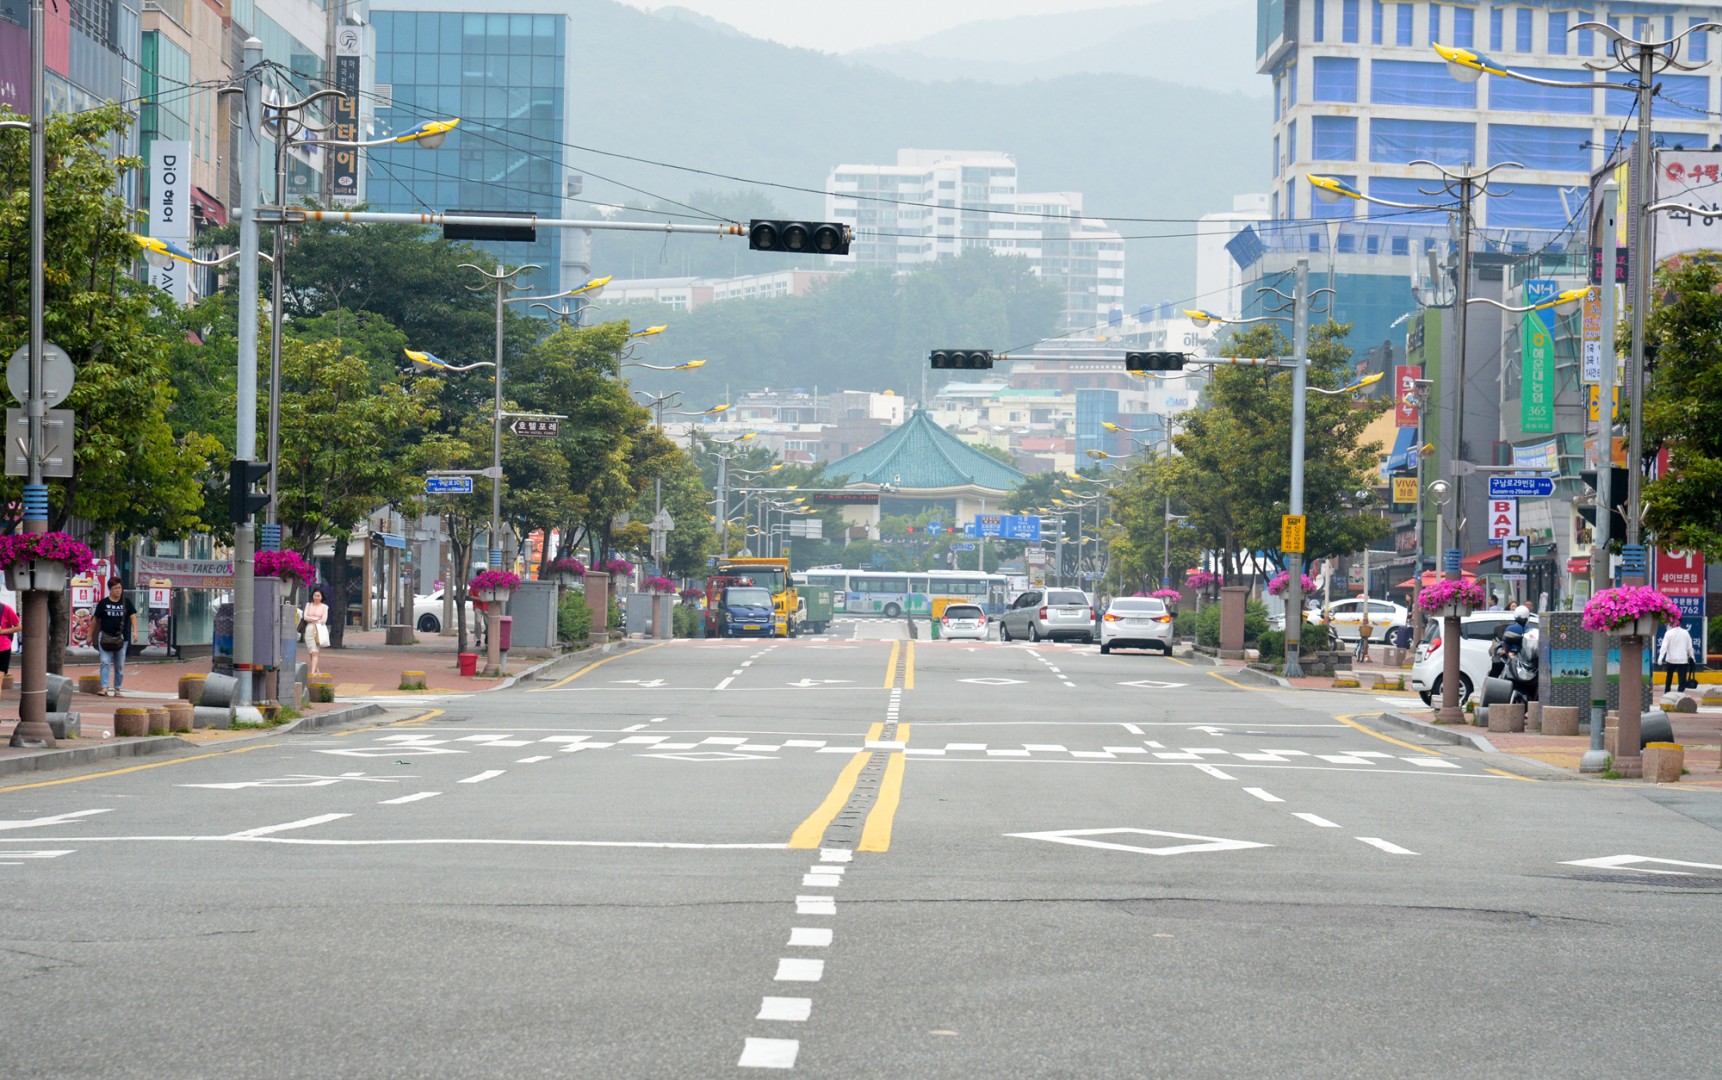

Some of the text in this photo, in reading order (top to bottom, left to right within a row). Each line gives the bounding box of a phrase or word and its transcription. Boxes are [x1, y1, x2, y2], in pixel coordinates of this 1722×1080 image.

[337, 96, 356, 173] 더타이
[163, 155, 176, 185] DiO
[1595, 268, 1625, 278] BR
[1528, 284, 1553, 294] NH
[1528, 406, 1546, 416] 365
[1395, 480, 1417, 488] VIVA
[1492, 479, 1535, 488] 구남로29번길
[193, 564, 233, 574] TAKE-OU
